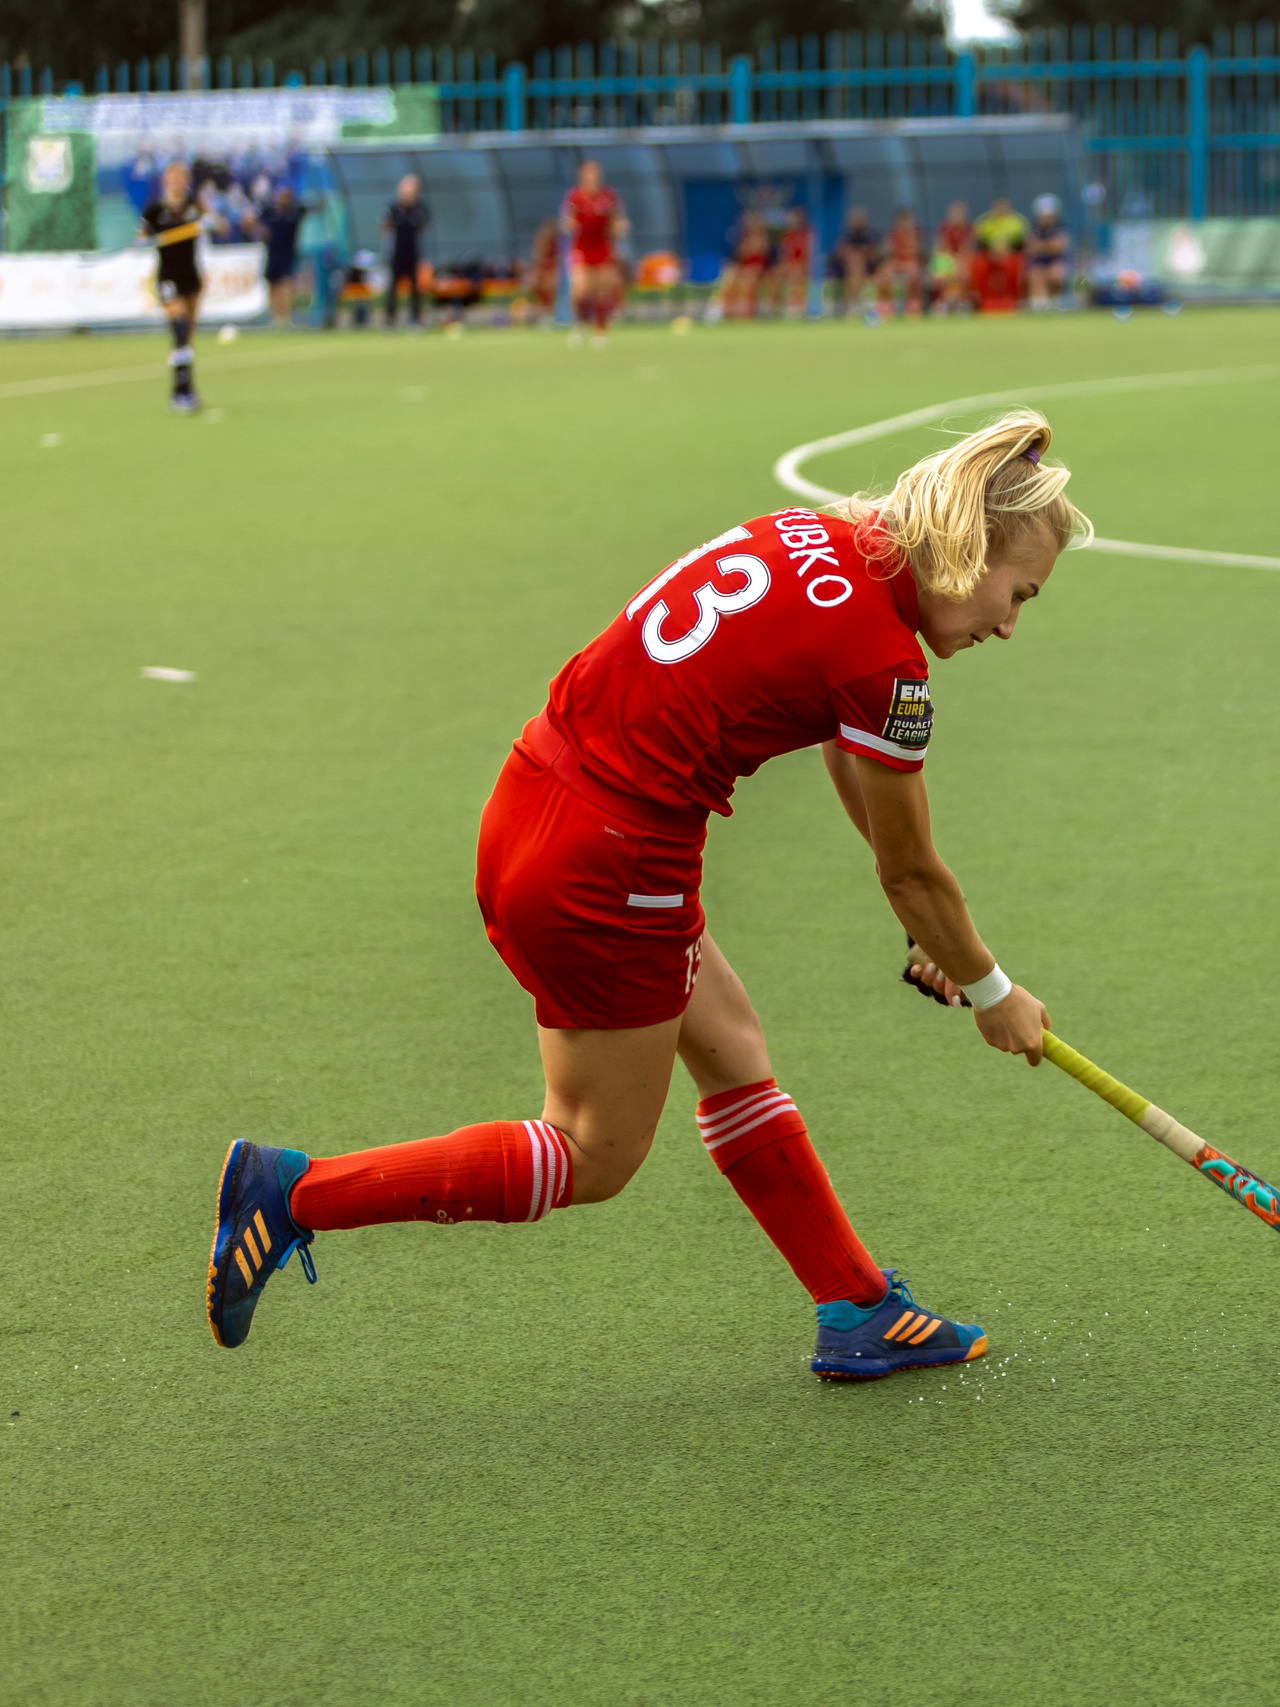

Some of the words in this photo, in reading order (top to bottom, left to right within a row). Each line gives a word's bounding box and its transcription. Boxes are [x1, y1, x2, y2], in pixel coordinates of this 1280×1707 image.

[626, 526, 772, 665] 13
[897, 702, 925, 716] EURO
[889, 727, 929, 742] LEAGUE
